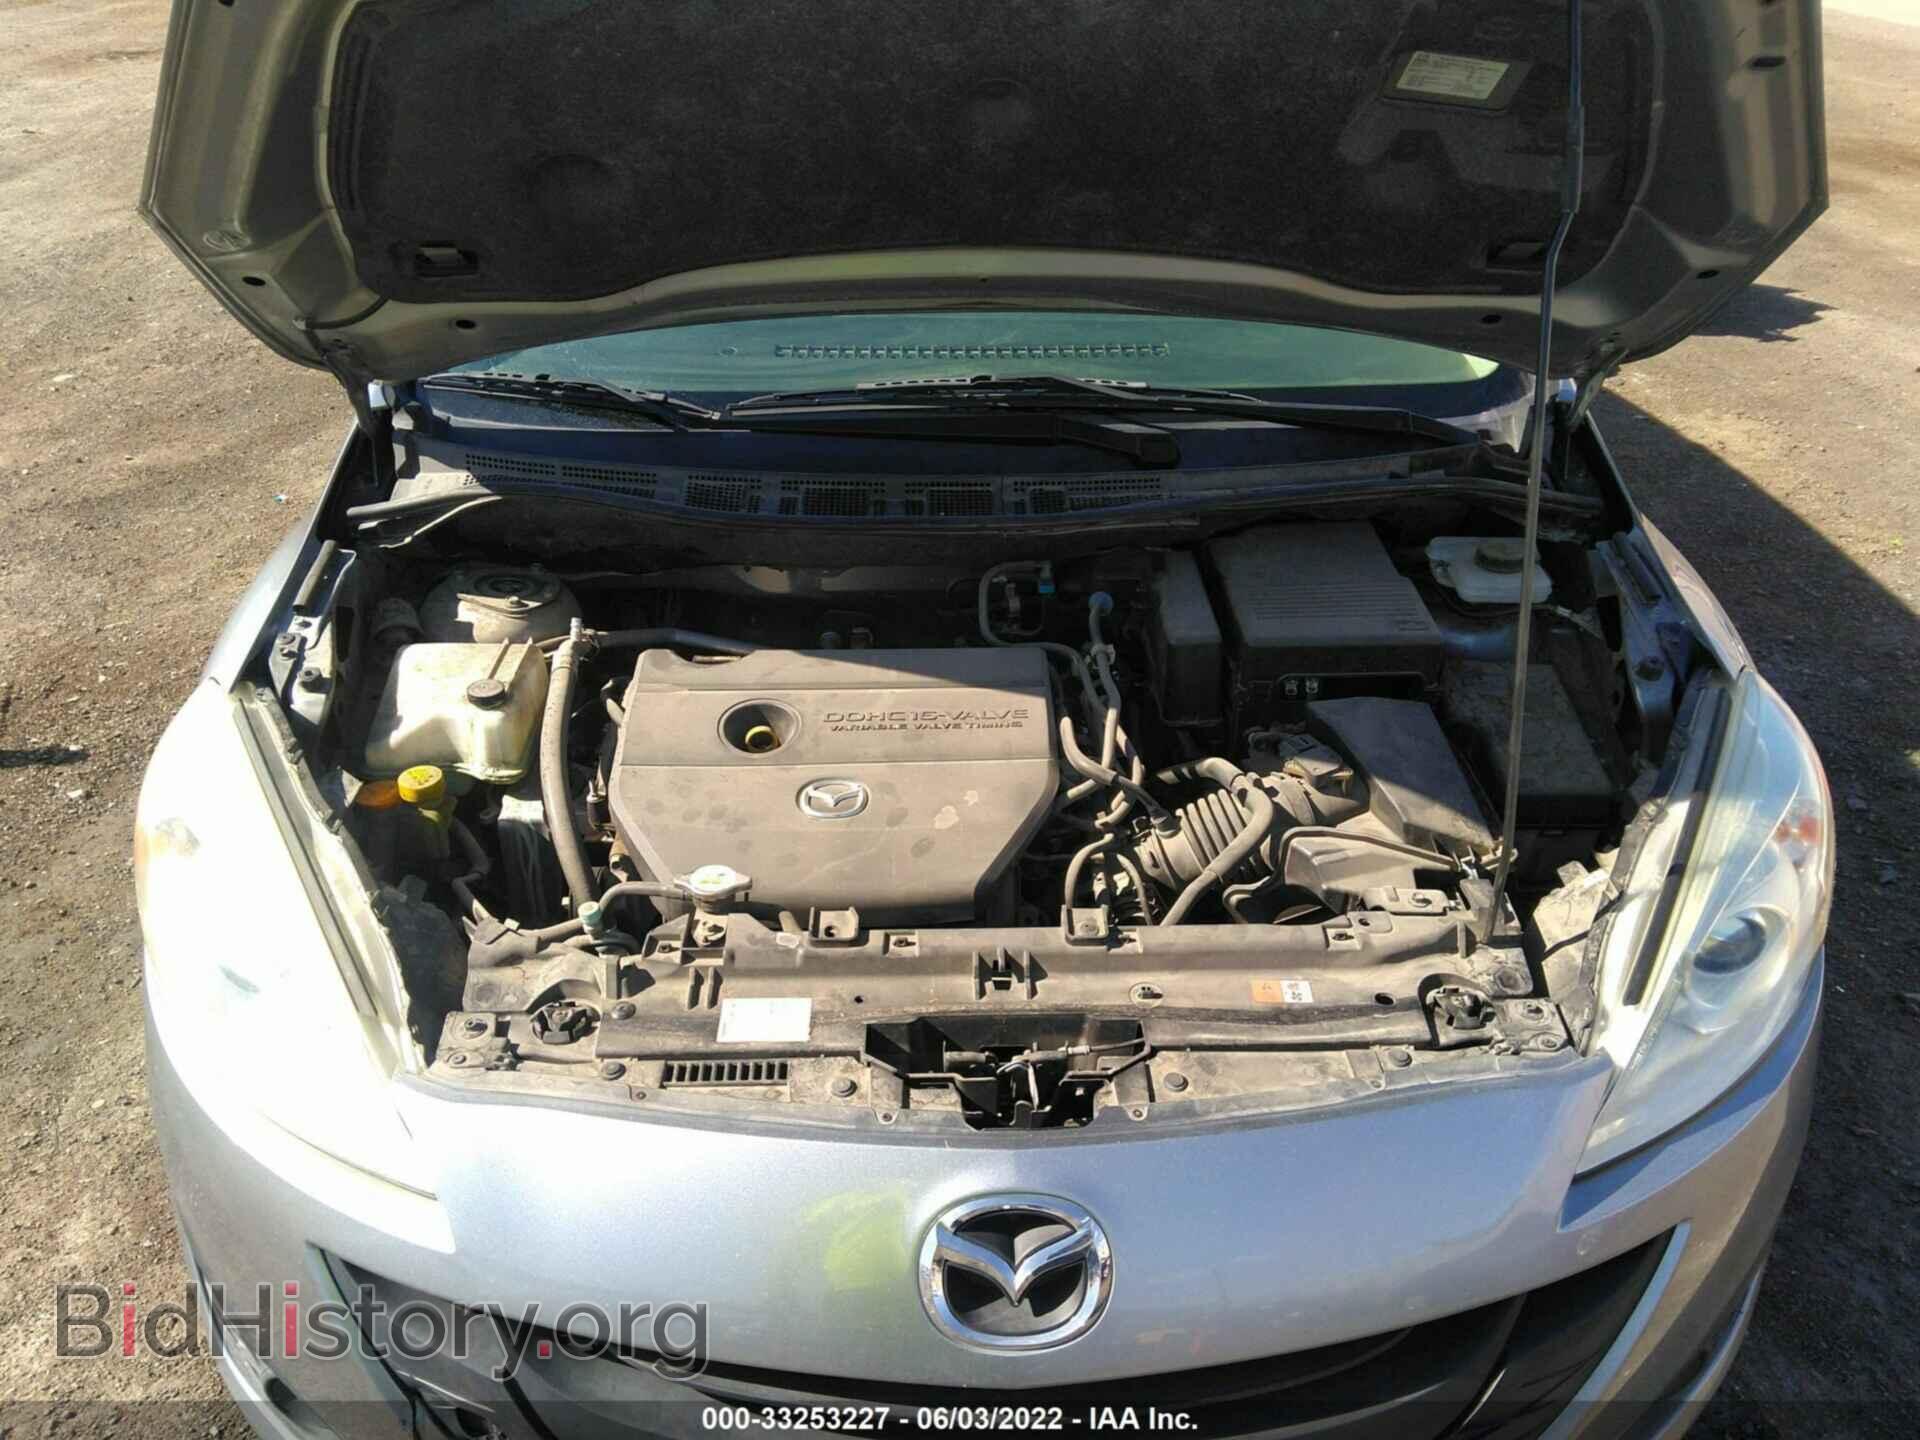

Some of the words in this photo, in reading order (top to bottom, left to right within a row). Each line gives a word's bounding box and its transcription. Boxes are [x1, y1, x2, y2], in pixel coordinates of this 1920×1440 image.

[823, 710, 906, 723] DOHC
[830, 722, 909, 732] VARIABLE
[913, 722, 963, 730] VALVE
[965, 720, 1024, 729] TIMING
